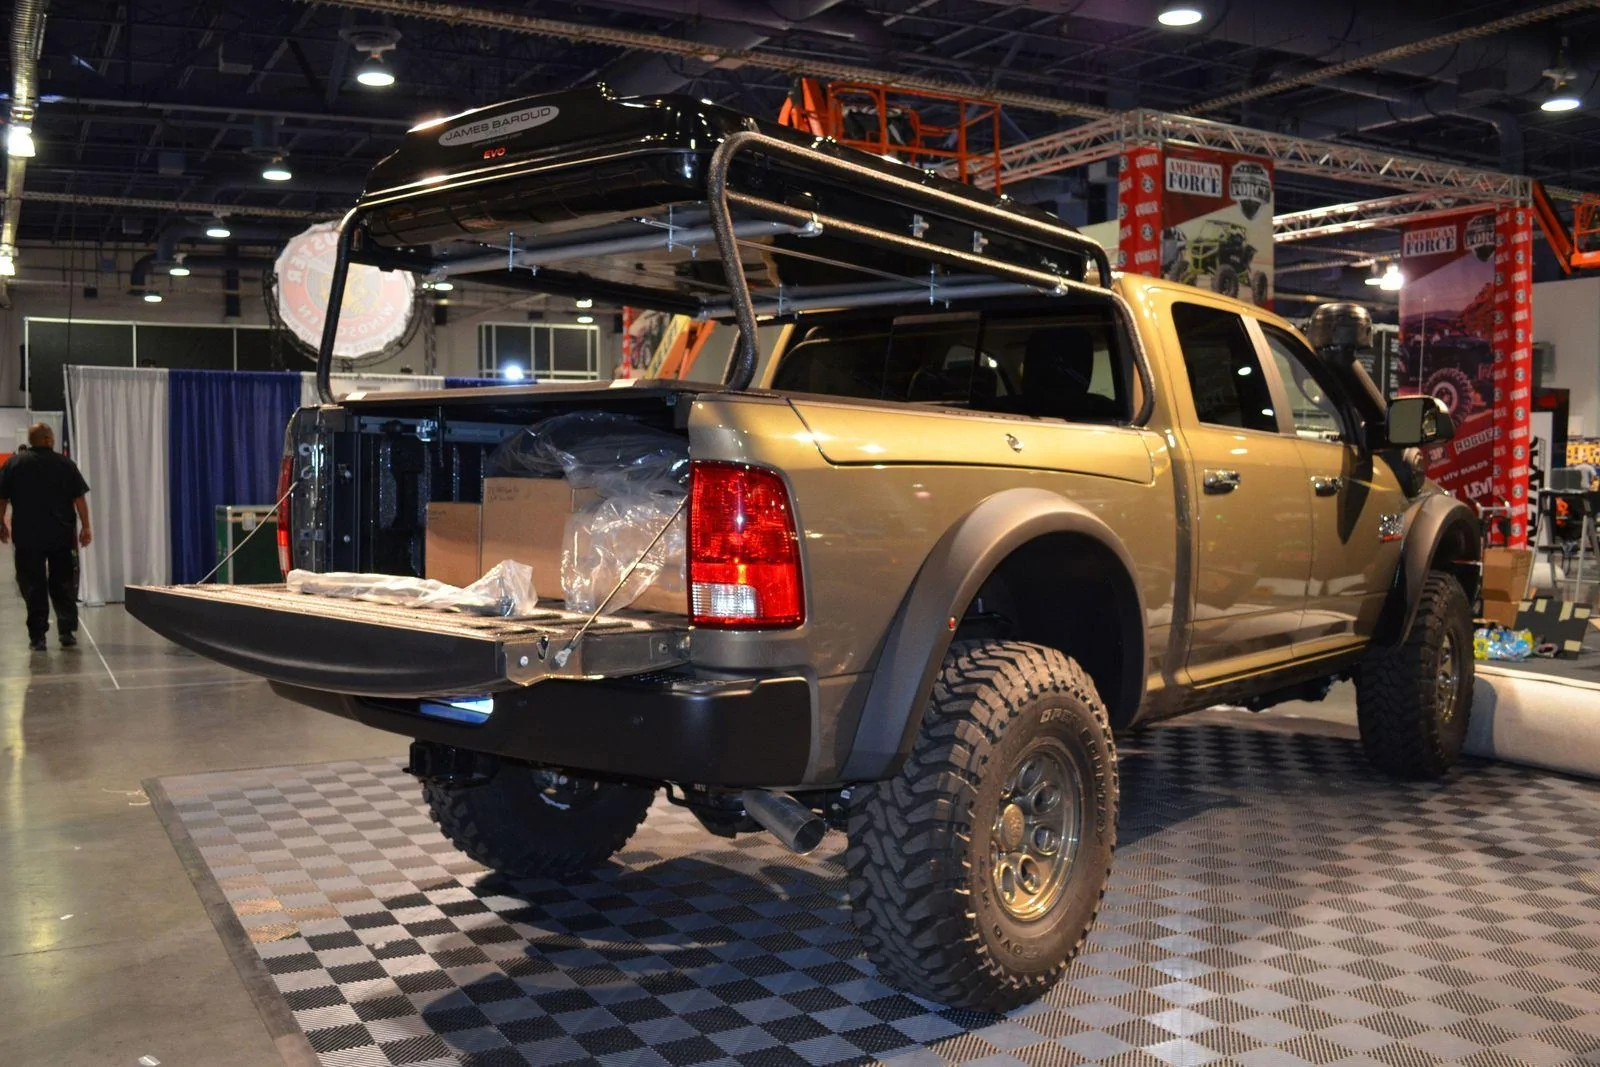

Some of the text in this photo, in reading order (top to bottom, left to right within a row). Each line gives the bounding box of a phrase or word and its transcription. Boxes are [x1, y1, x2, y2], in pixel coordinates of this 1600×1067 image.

[445, 123, 490, 141] JAMES
[492, 107, 551, 129] BAROUD
[483, 147, 506, 159] EVO
[1169, 161, 1221, 177] AMERICAN
[1168, 173, 1221, 195] FORCE
[1406, 227, 1455, 242] AMERICAN
[1406, 237, 1455, 255] FORCE
